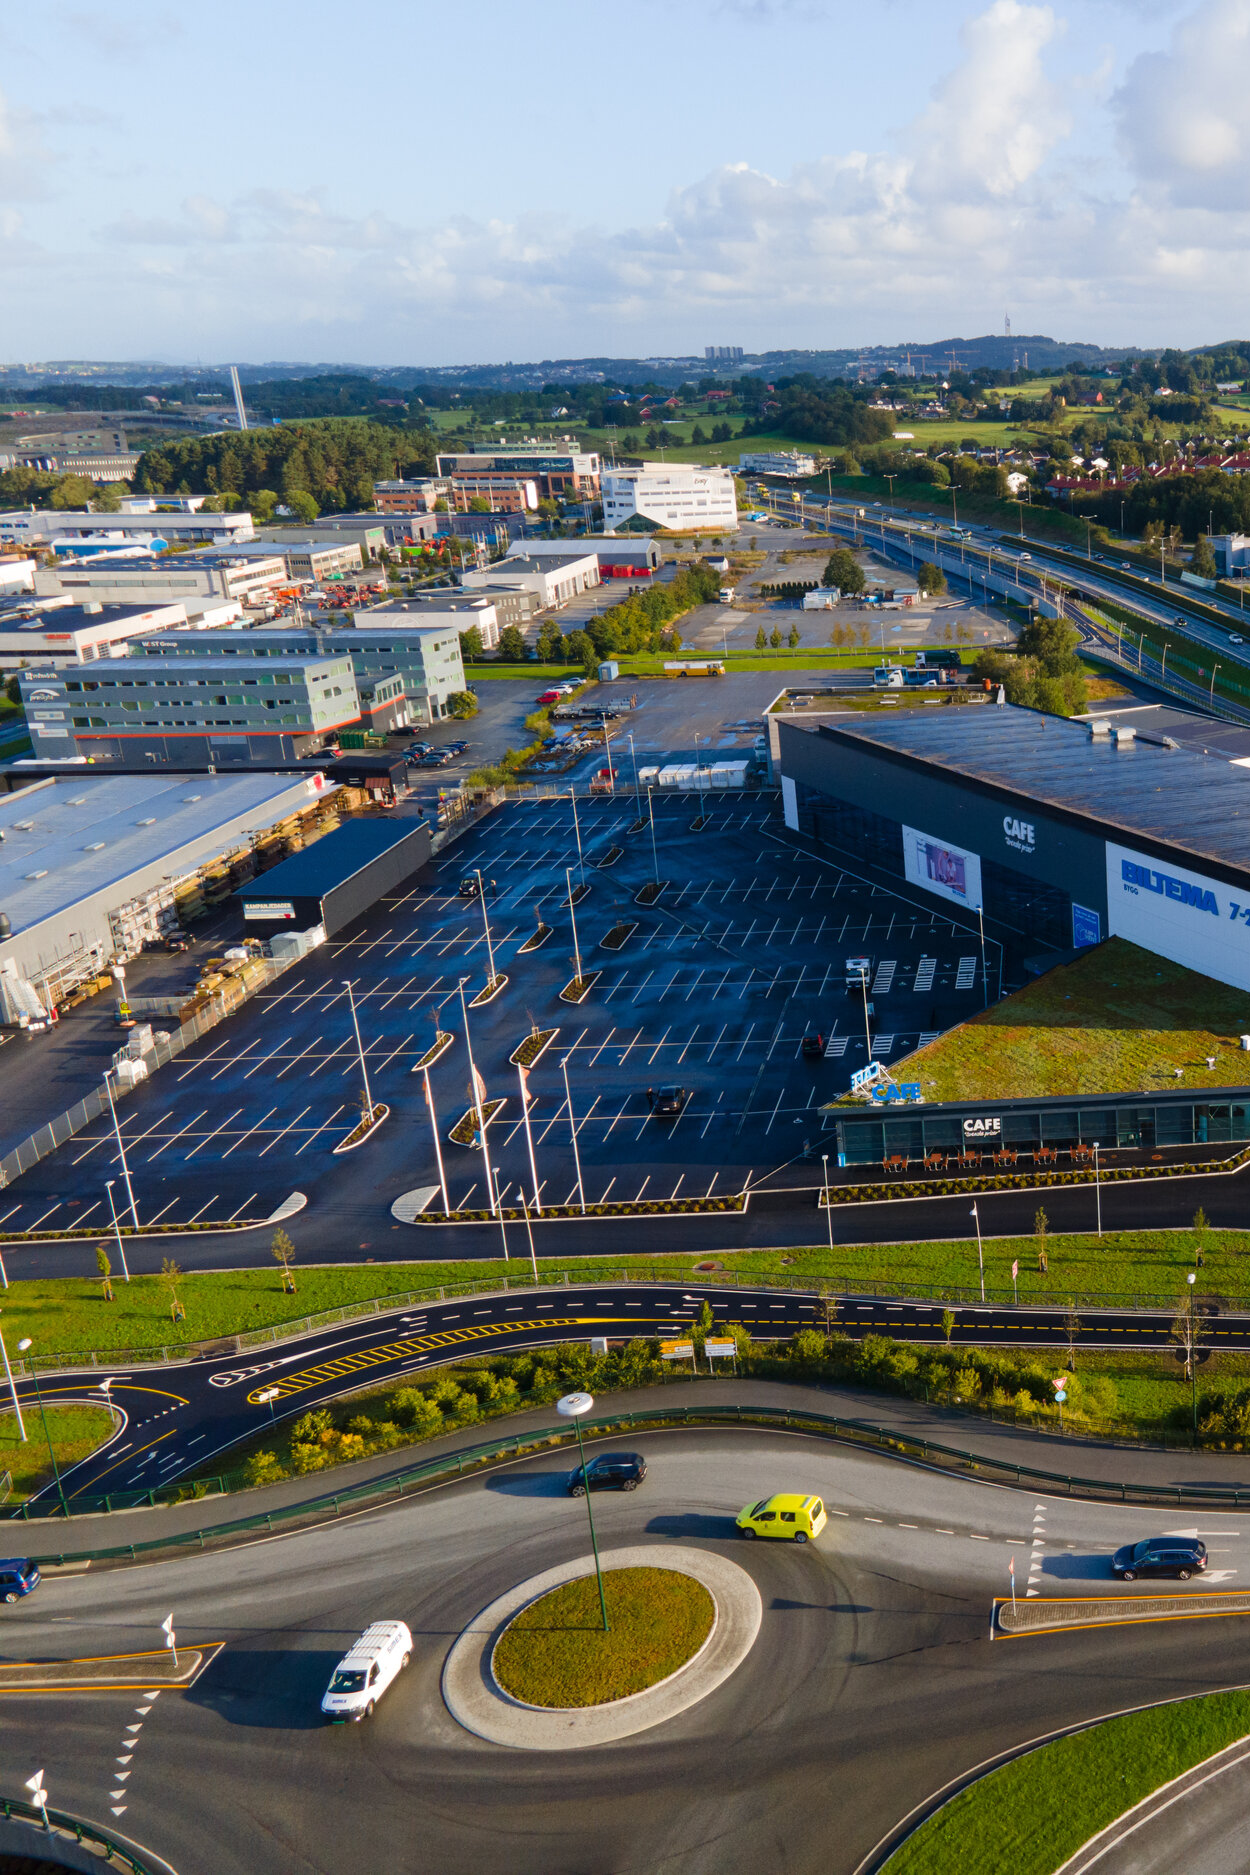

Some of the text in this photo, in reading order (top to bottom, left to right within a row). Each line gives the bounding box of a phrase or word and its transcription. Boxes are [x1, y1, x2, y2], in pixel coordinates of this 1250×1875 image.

[1003, 816, 1035, 844] CAFE
[1122, 859, 1219, 916] BILTEMA
[1123, 883, 1139, 896] BYGG
[871, 1083, 920, 1101] CAFE
[963, 1118, 1000, 1131] CAFE
